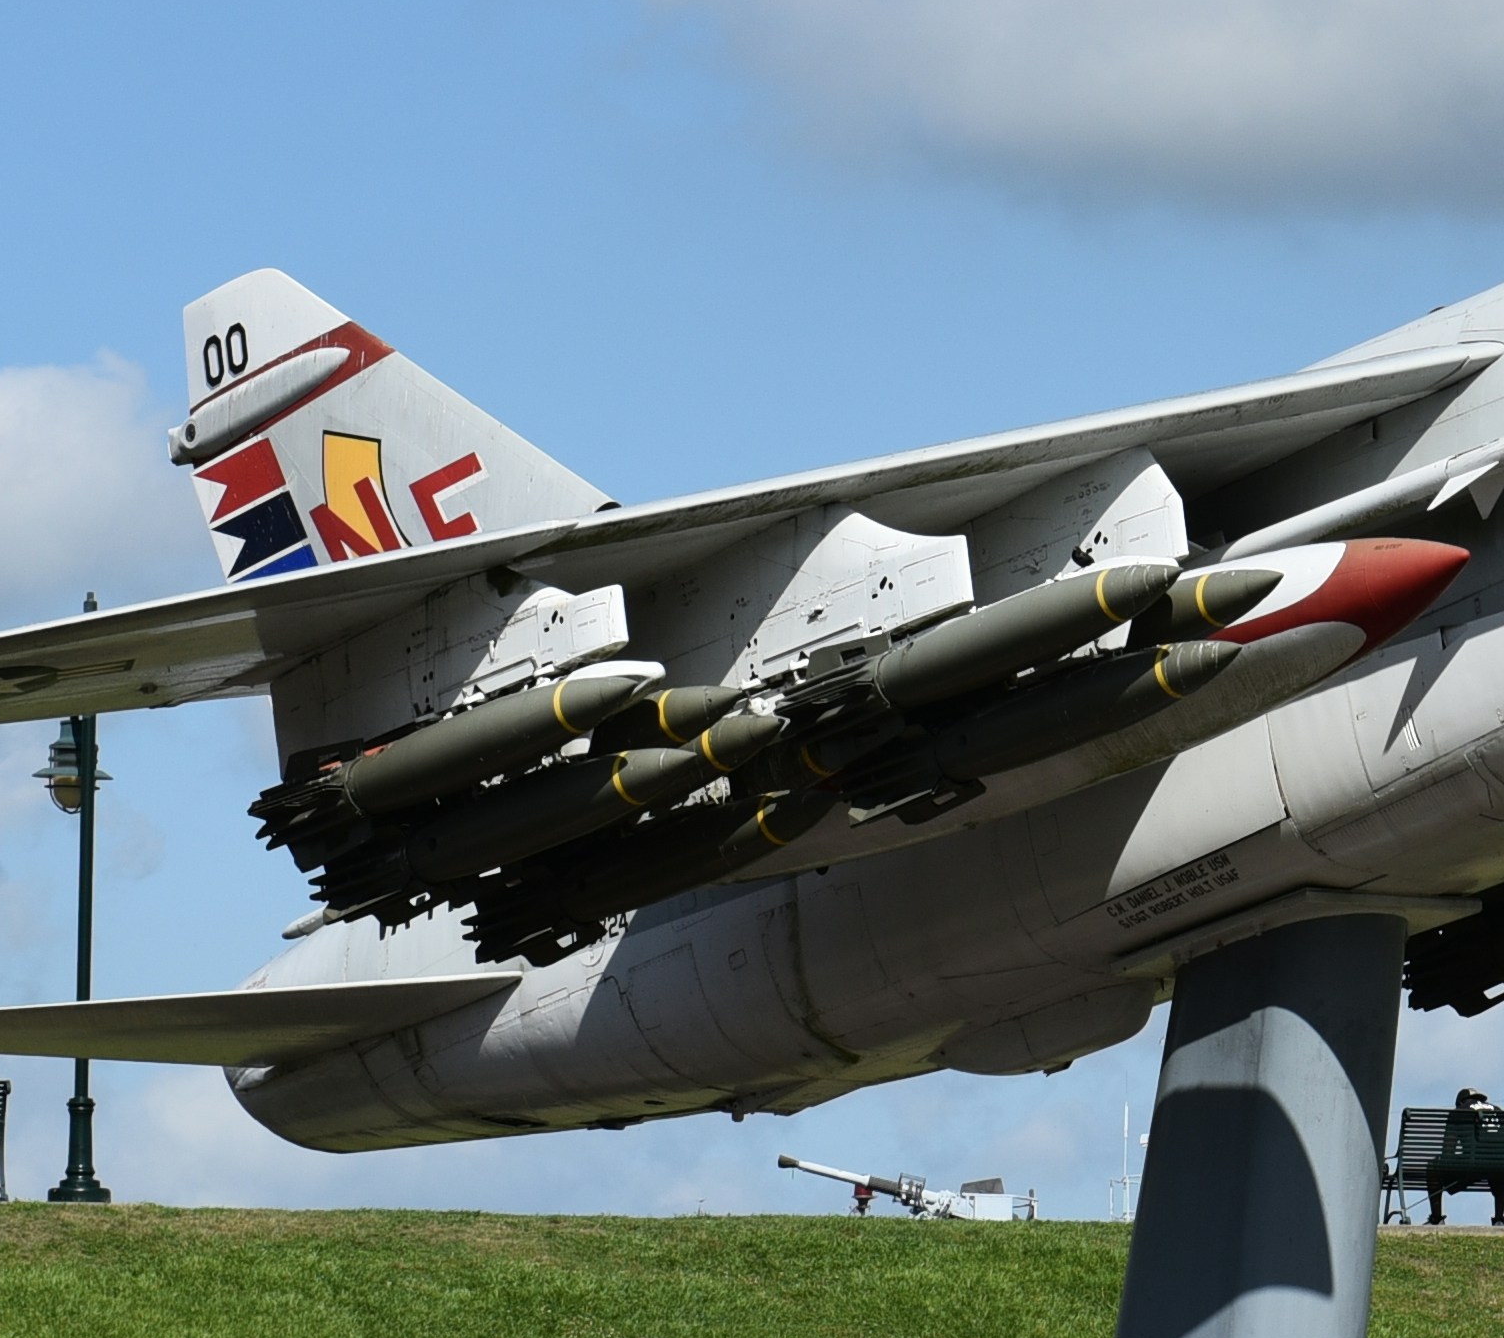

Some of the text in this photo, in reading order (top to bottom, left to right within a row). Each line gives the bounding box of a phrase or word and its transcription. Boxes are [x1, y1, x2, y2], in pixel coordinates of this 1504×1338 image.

[202, 321, 249, 389] 00
[1126, 886, 1163, 909] DANIEL
[1173, 863, 1209, 887] NOBLE
[1207, 852, 1231, 871] USN
[1148, 892, 1190, 916] ROBERT
[1186, 880, 1215, 899] HOLT
[1212, 868, 1240, 887] USAF
